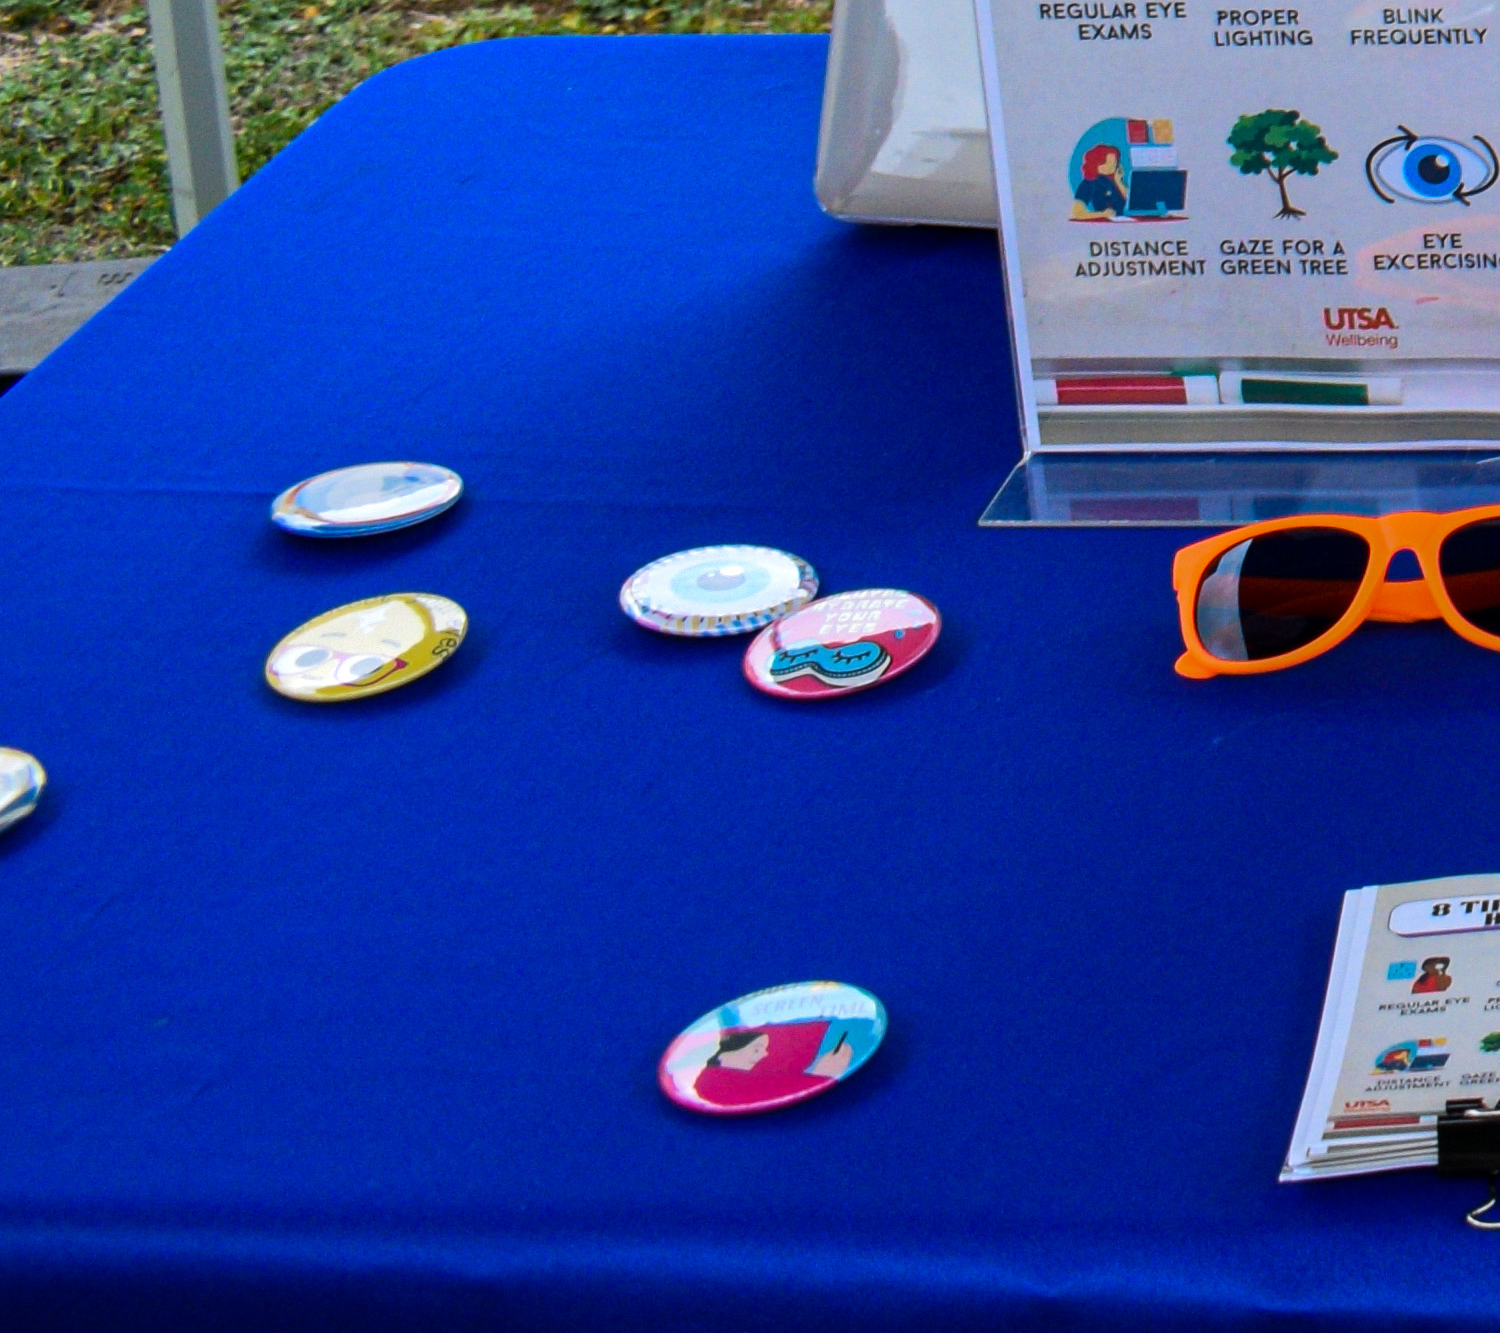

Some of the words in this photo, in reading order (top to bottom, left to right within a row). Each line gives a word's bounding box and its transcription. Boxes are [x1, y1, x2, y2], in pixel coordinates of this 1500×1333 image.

[1039, 3, 1136, 20] REGULAR
[1146, 1, 1187, 19] EYE
[1217, 9, 1299, 26] PROPER
[1383, 9, 1444, 25] BLINK
[1078, 23, 1152, 41] EXAMS
[1214, 29, 1313, 47] LIGHTING
[1350, 28, 1488, 46] FREQUENTLY
[1090, 240, 1188, 257] DISTANCE
[1220, 239, 1274, 256] GAZE
[1283, 239, 1324, 256] FOR
[1333, 240, 1345, 256] A
[1423, 234, 1463, 249] EYE
[1075, 259, 1206, 277] ADJUSTMENT
[1221, 259, 1292, 275] GREEN
[1299, 259, 1348, 275] TREE
[1324, 307, 1397, 330] UTSA
[1326, 334, 1398, 349] Wellbeing
[1431, 902, 1451, 917] 8
[1378, 999, 1439, 1011] REGULAR
[1445, 996, 1470, 1005] EYE
[1400, 1006, 1447, 1016] EXAMS
